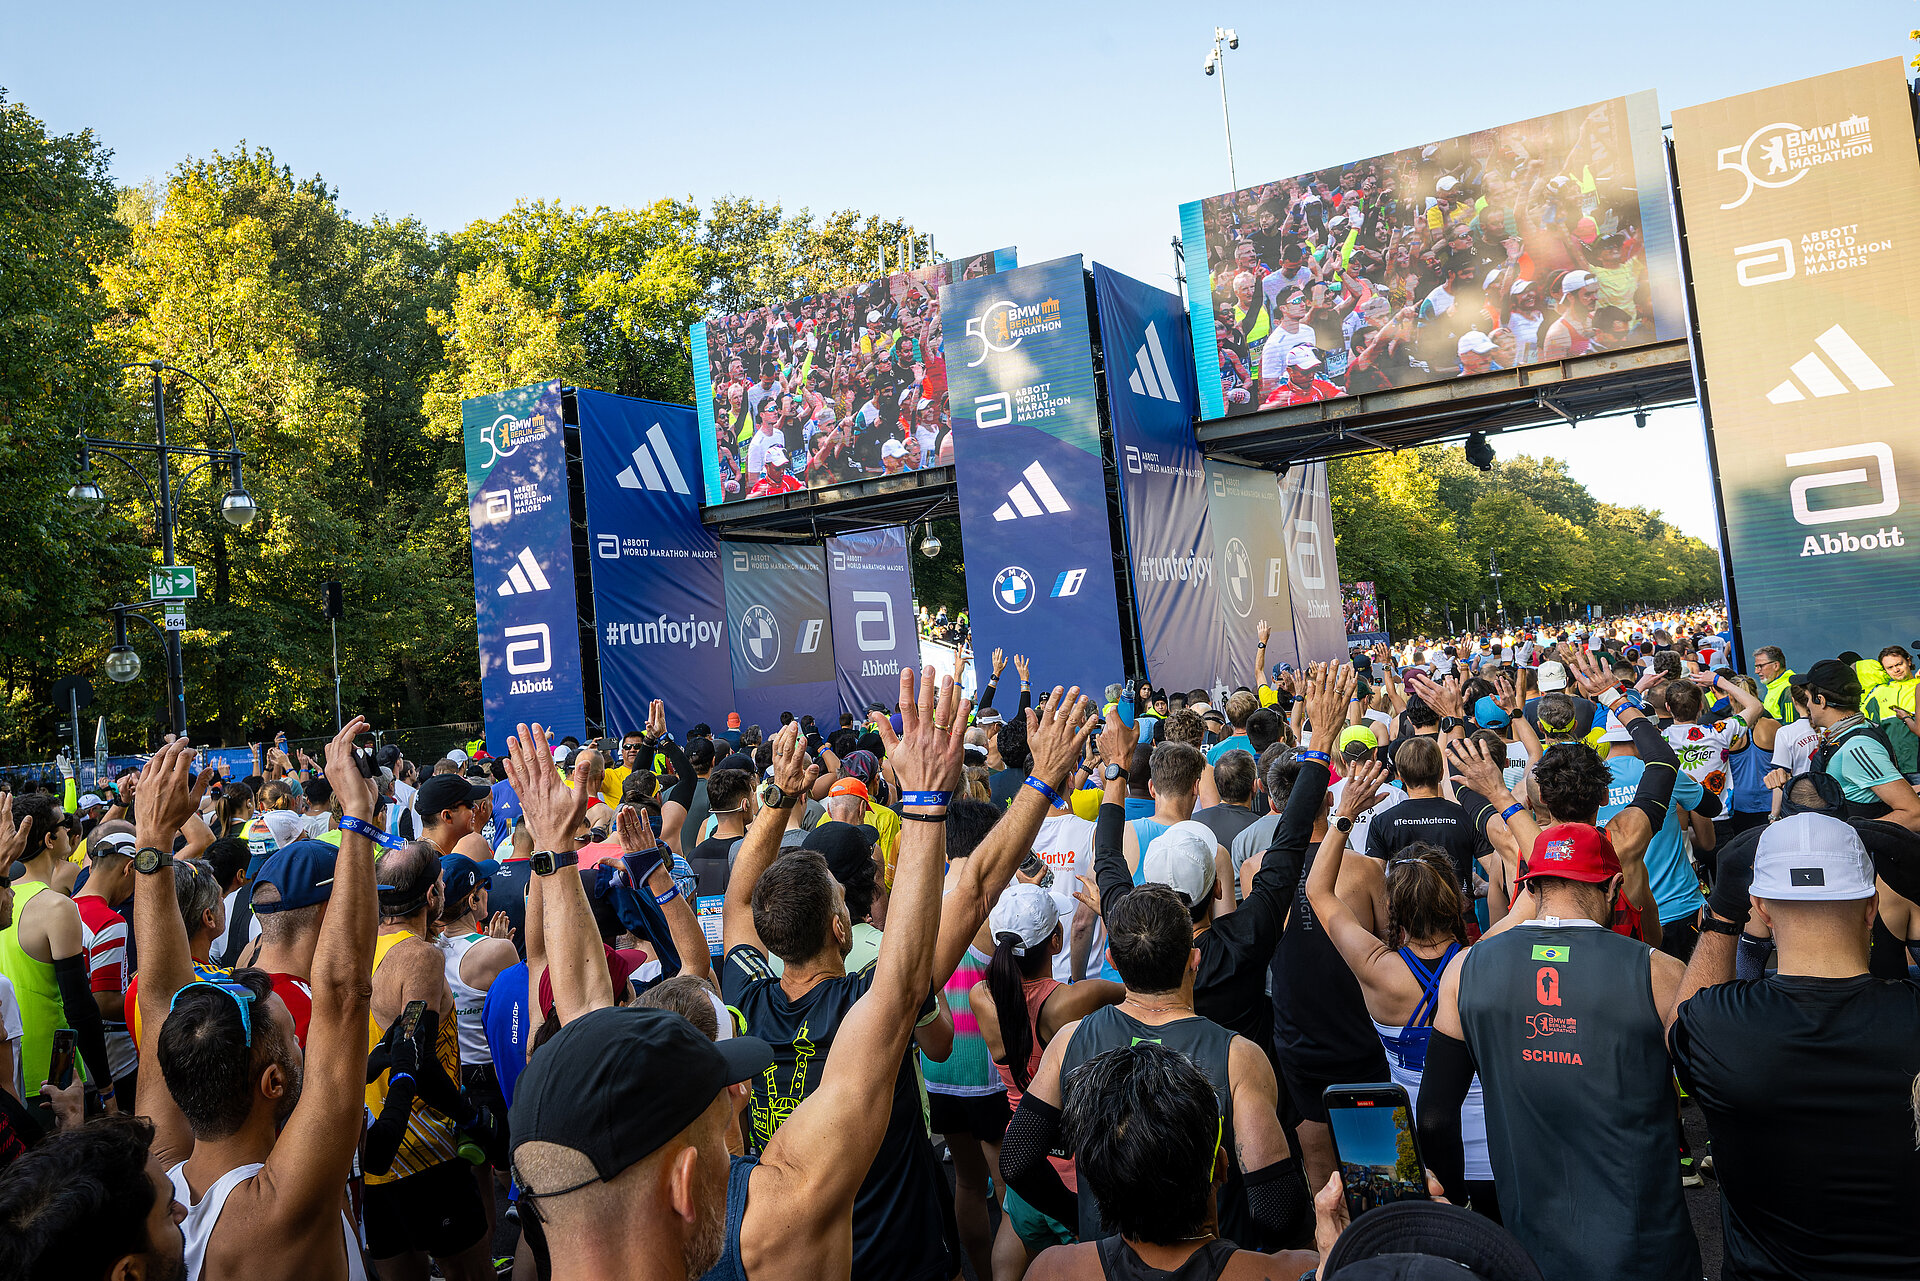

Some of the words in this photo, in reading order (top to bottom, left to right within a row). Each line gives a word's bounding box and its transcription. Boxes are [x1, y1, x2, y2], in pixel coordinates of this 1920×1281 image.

[1786, 123, 1837, 148] BMW
[1788, 138, 1840, 158] BERLIN
[1789, 144, 1873, 170] MARATHON
[1717, 122, 1810, 210] 50
[1800, 224, 1858, 244] ABBOTT
[1801, 236, 1855, 253] WORLD
[1804, 240, 1892, 266] MARATHON
[1805, 256, 1868, 276] MAJORS
[1008, 303, 1040, 321] BMW
[1010, 315, 1042, 330] BERLIN
[1010, 320, 1062, 339] MARATHON
[966, 300, 1023, 368] 50
[1016, 382, 1050, 396] ABBOTT
[1016, 392, 1048, 405] WORLD
[1017, 396, 1071, 414] MARATHON
[1017, 408, 1056, 422] MAJORS
[510, 418, 532, 431] BMW
[510, 428, 532, 438] BERLIN
[480, 414, 519, 468] 50
[511, 432, 546, 446] MARATHON
[1142, 452, 1159, 462] ABBOTT
[1143, 463, 1159, 472] WORLD
[1160, 467, 1184, 476] MARATHON
[514, 484, 538, 494] ABBOTT
[514, 490, 536, 500] WORLD
[514, 495, 552, 507] MARATHON
[515, 504, 541, 514] MAJORS
[622, 539, 649, 547] ABBOTT
[1800, 526, 1904, 557] Abbott
[622, 548, 648, 557] WORLD
[650, 550, 688, 558] MARATHON
[1140, 549, 1213, 588] #runforjoy
[1307, 600, 1331, 618] Abbott
[606, 614, 722, 649] #runforjoy
[861, 659, 899, 676] Abbott
[509, 679, 553, 695] Abbott
[1394, 817, 1457, 826] #TeamMaterna
[1522, 1049, 1583, 1066] SCHIMA
